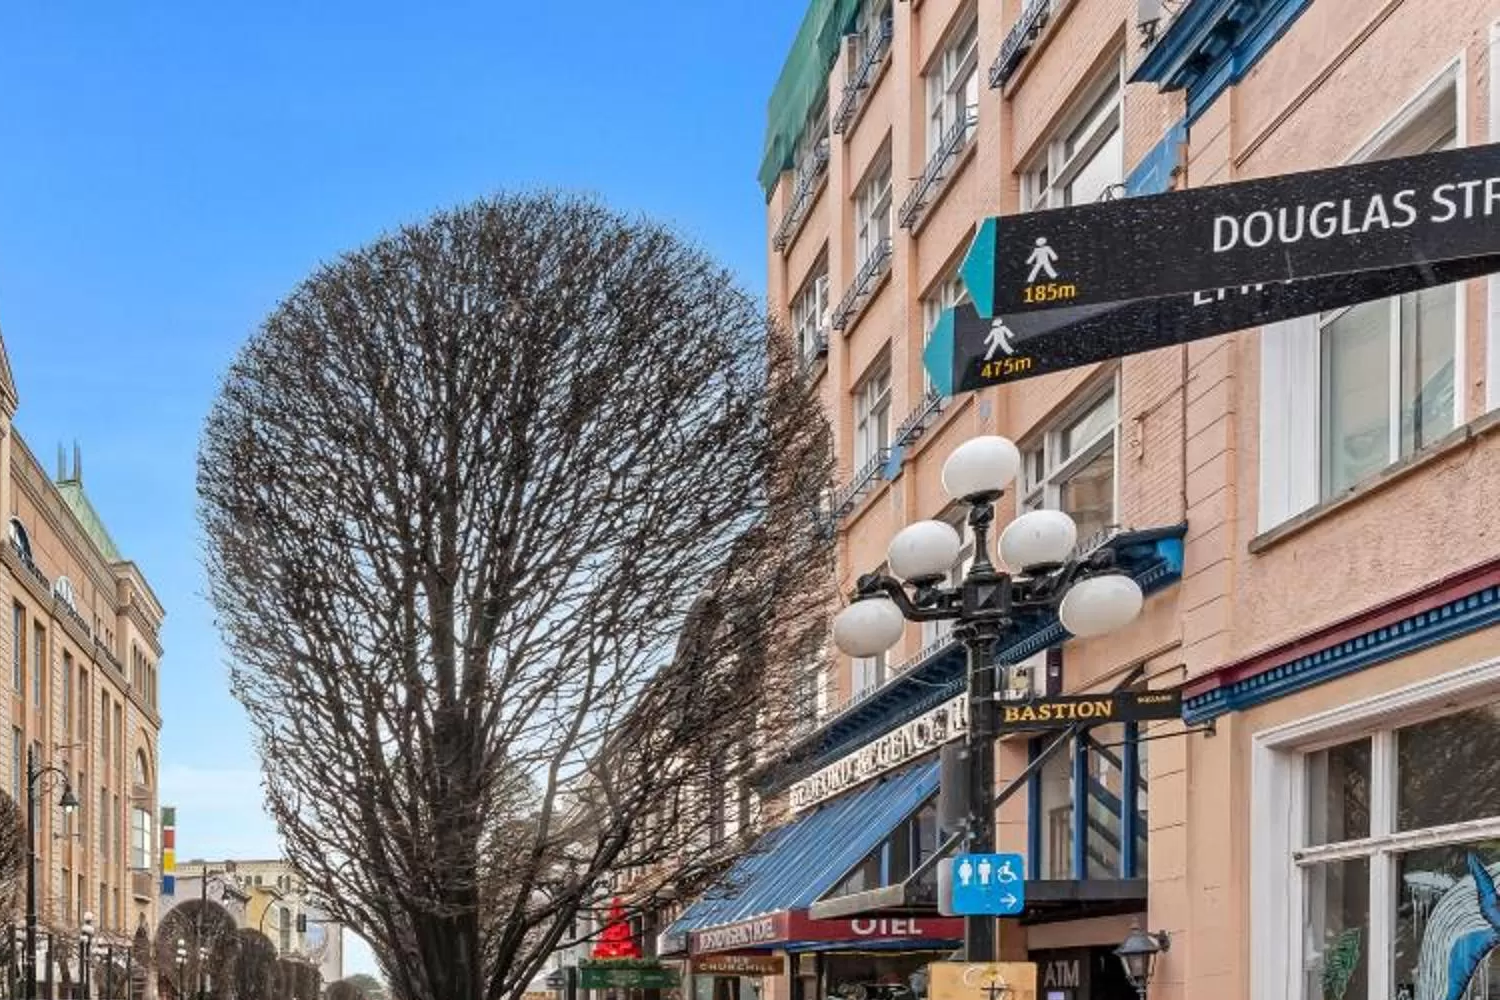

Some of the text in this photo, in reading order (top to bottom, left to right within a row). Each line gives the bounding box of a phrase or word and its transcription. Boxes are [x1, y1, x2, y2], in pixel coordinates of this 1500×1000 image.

[1213, 189, 1418, 253] DOUGLAS
[1023, 284, 1076, 303] 185m
[981, 357, 1032, 378] 475m
[1004, 701, 1113, 723] BASTION
[1044, 960, 1079, 987] ATM
